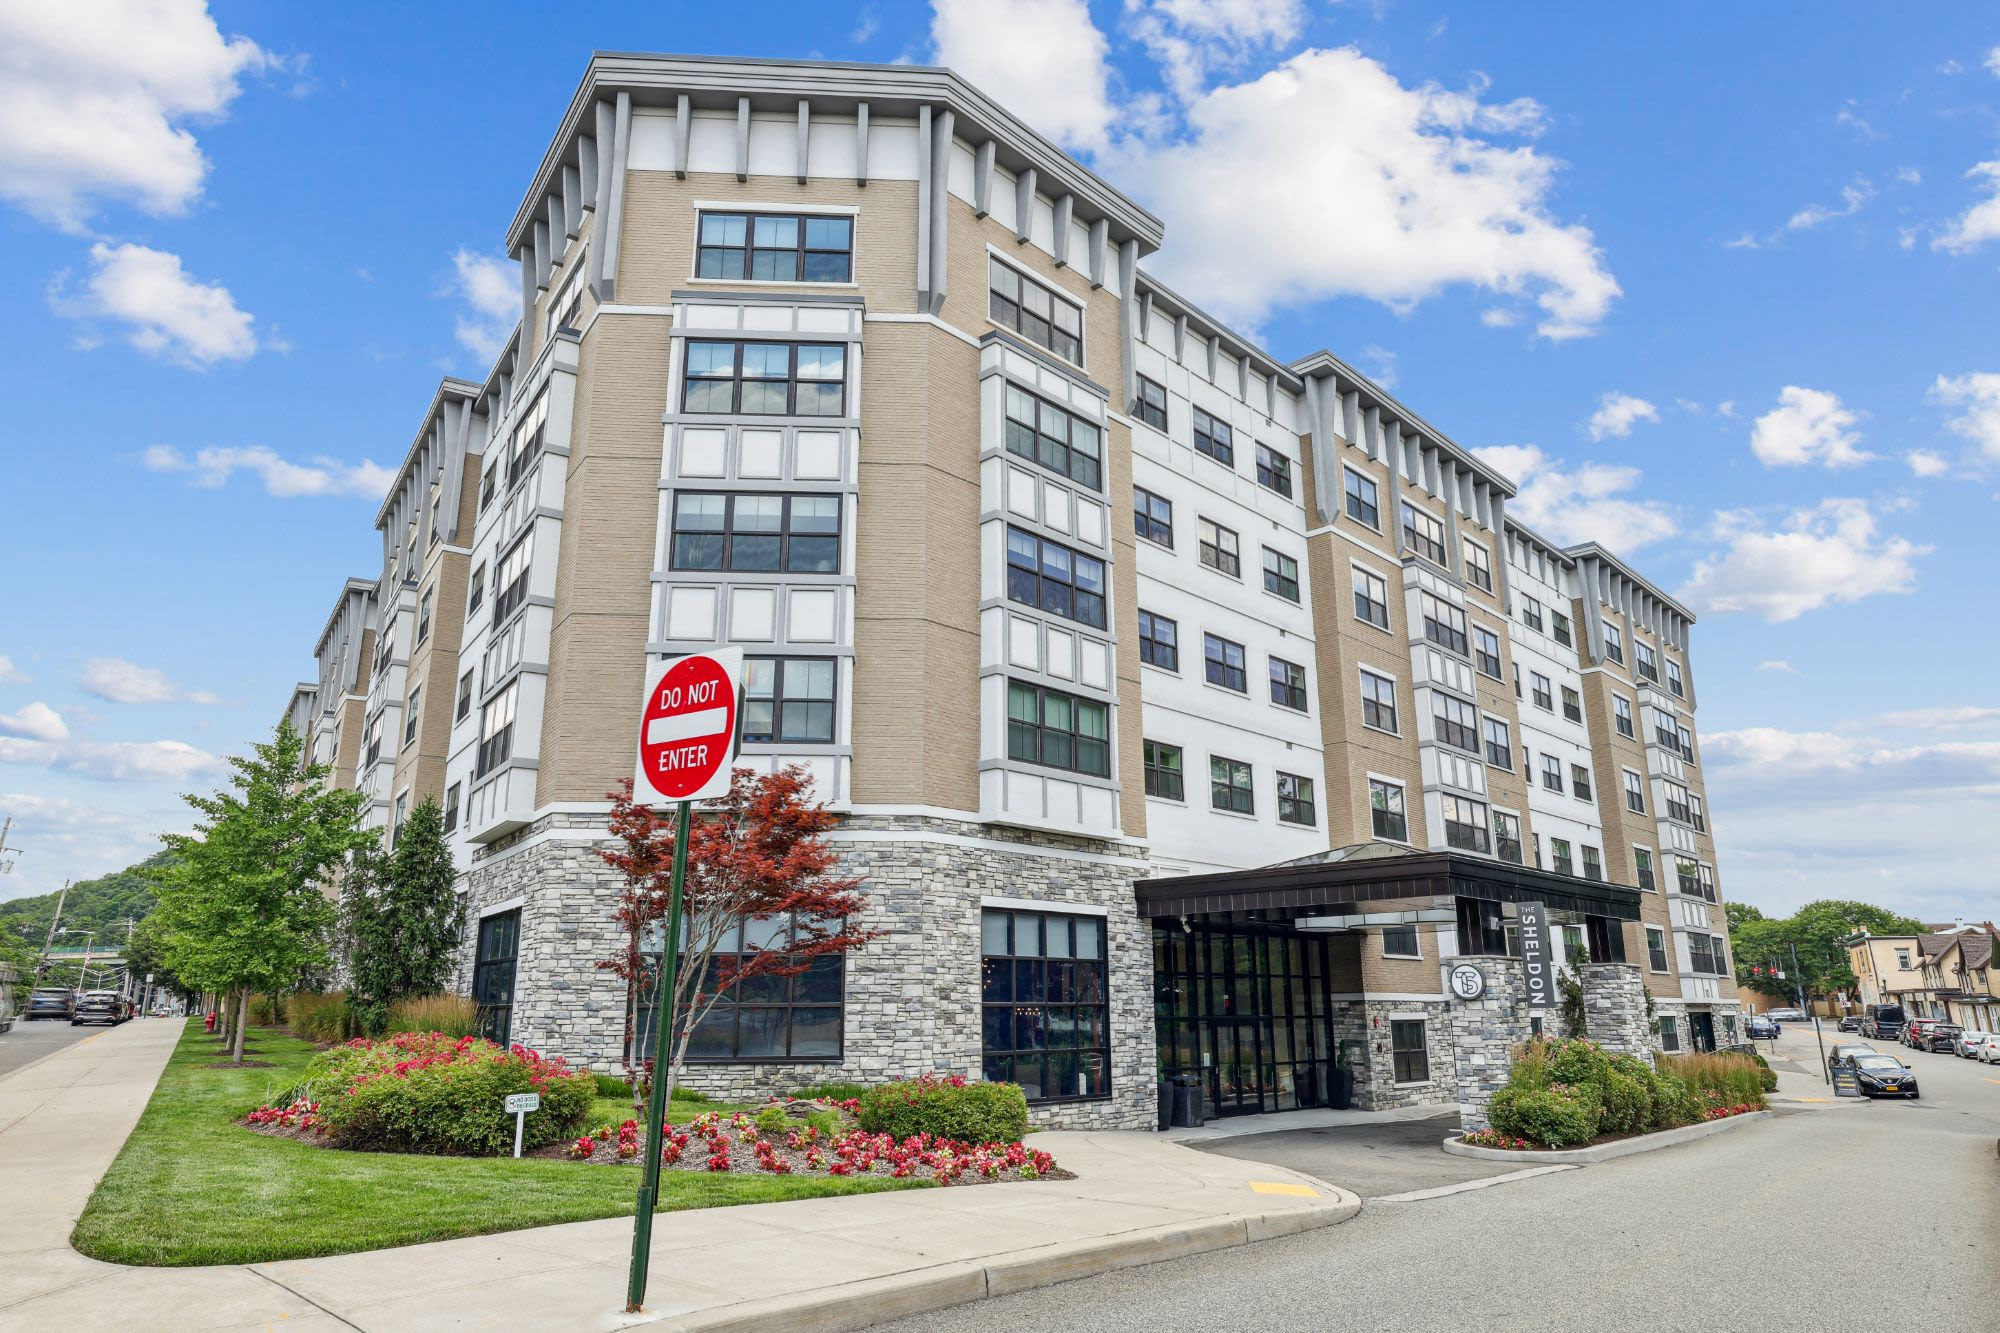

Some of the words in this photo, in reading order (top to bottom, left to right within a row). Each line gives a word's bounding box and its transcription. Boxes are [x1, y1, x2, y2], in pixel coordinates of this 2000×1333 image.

[660, 687, 682, 710] DO
[688, 680, 719, 706] NOT
[658, 745, 708, 772] ENTER
[1521, 906, 1536, 914] THE
[1522, 915, 1546, 1004] SHELDON
